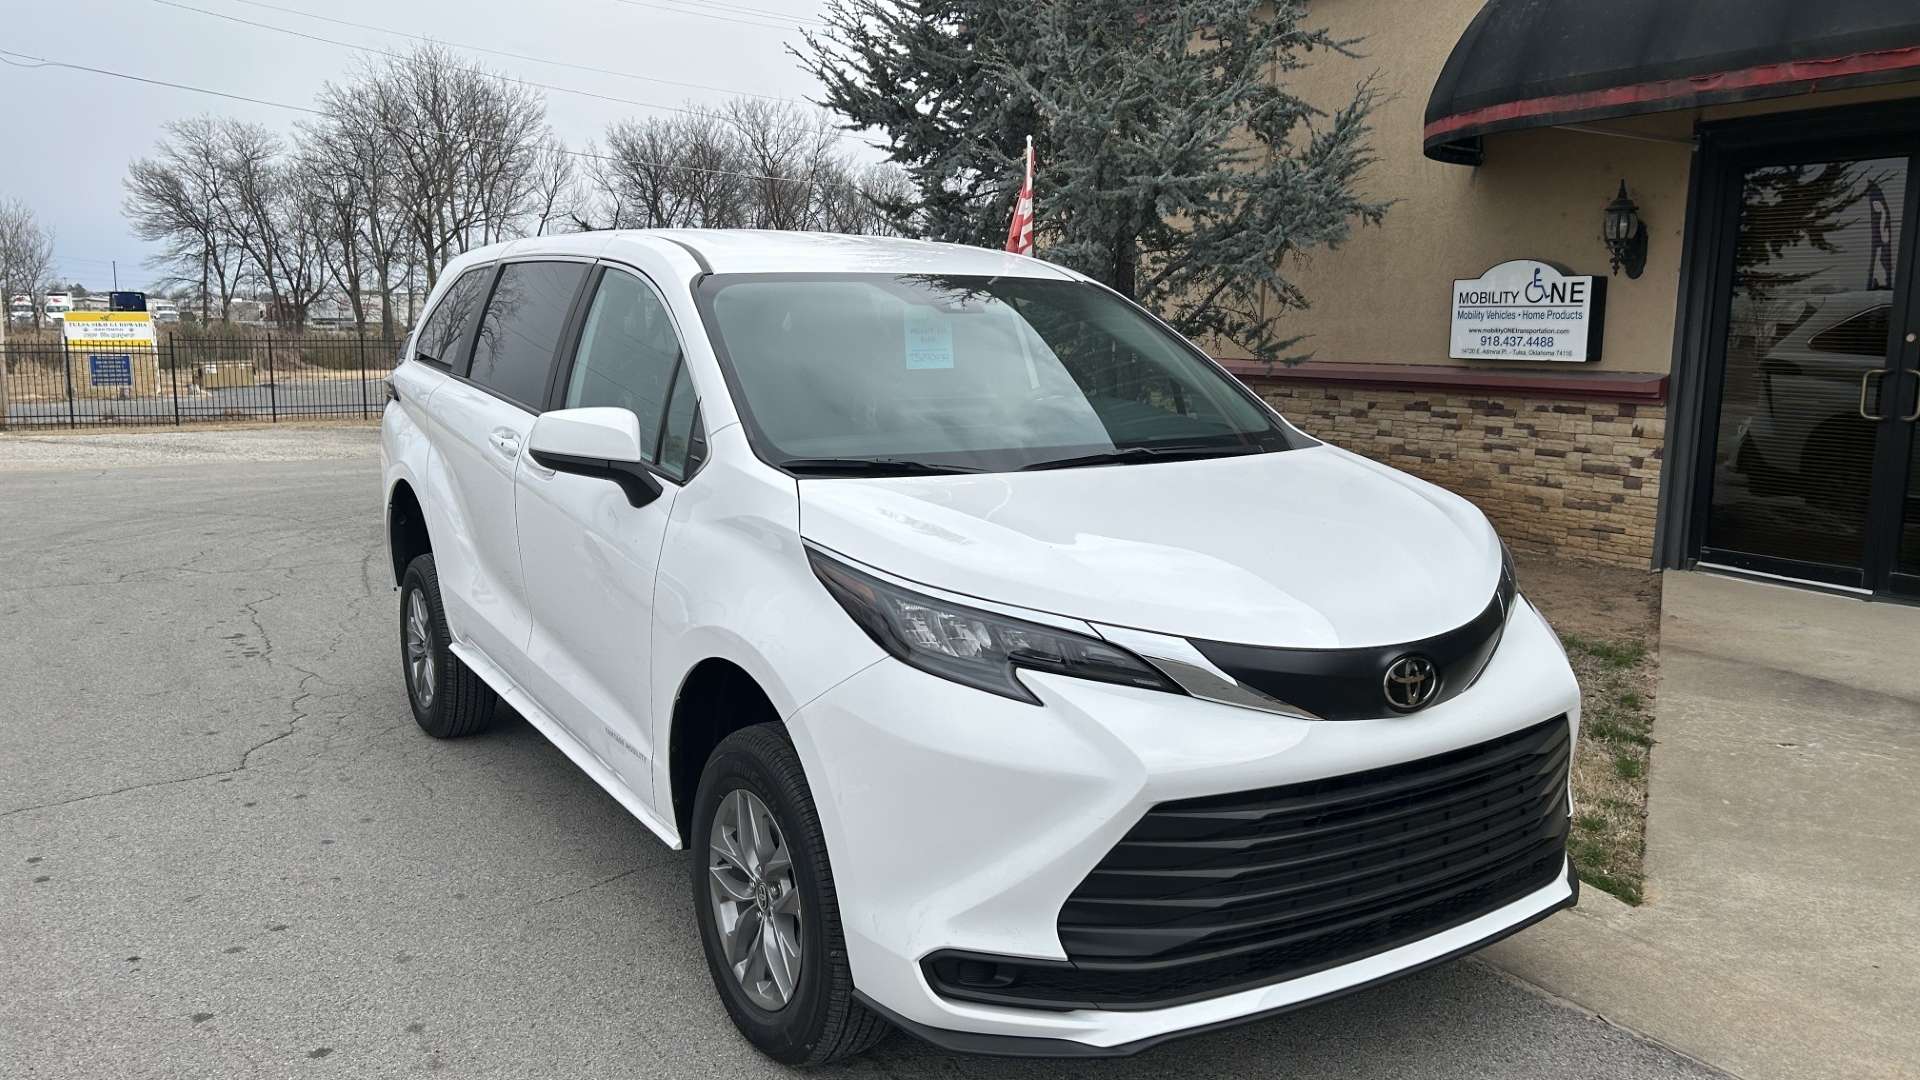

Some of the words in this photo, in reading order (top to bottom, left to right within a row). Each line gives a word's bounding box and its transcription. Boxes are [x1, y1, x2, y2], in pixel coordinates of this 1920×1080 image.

[1459, 291, 1519, 304] MOBILITY
[1525, 280, 1585, 304] ONE
[1457, 310, 1485, 321] Mobility
[1487, 310, 1516, 320] Vehicles
[1522, 310, 1546, 320] Home
[1547, 310, 1583, 320] Products
[1480, 336, 1554, 347] 918.437.4488
